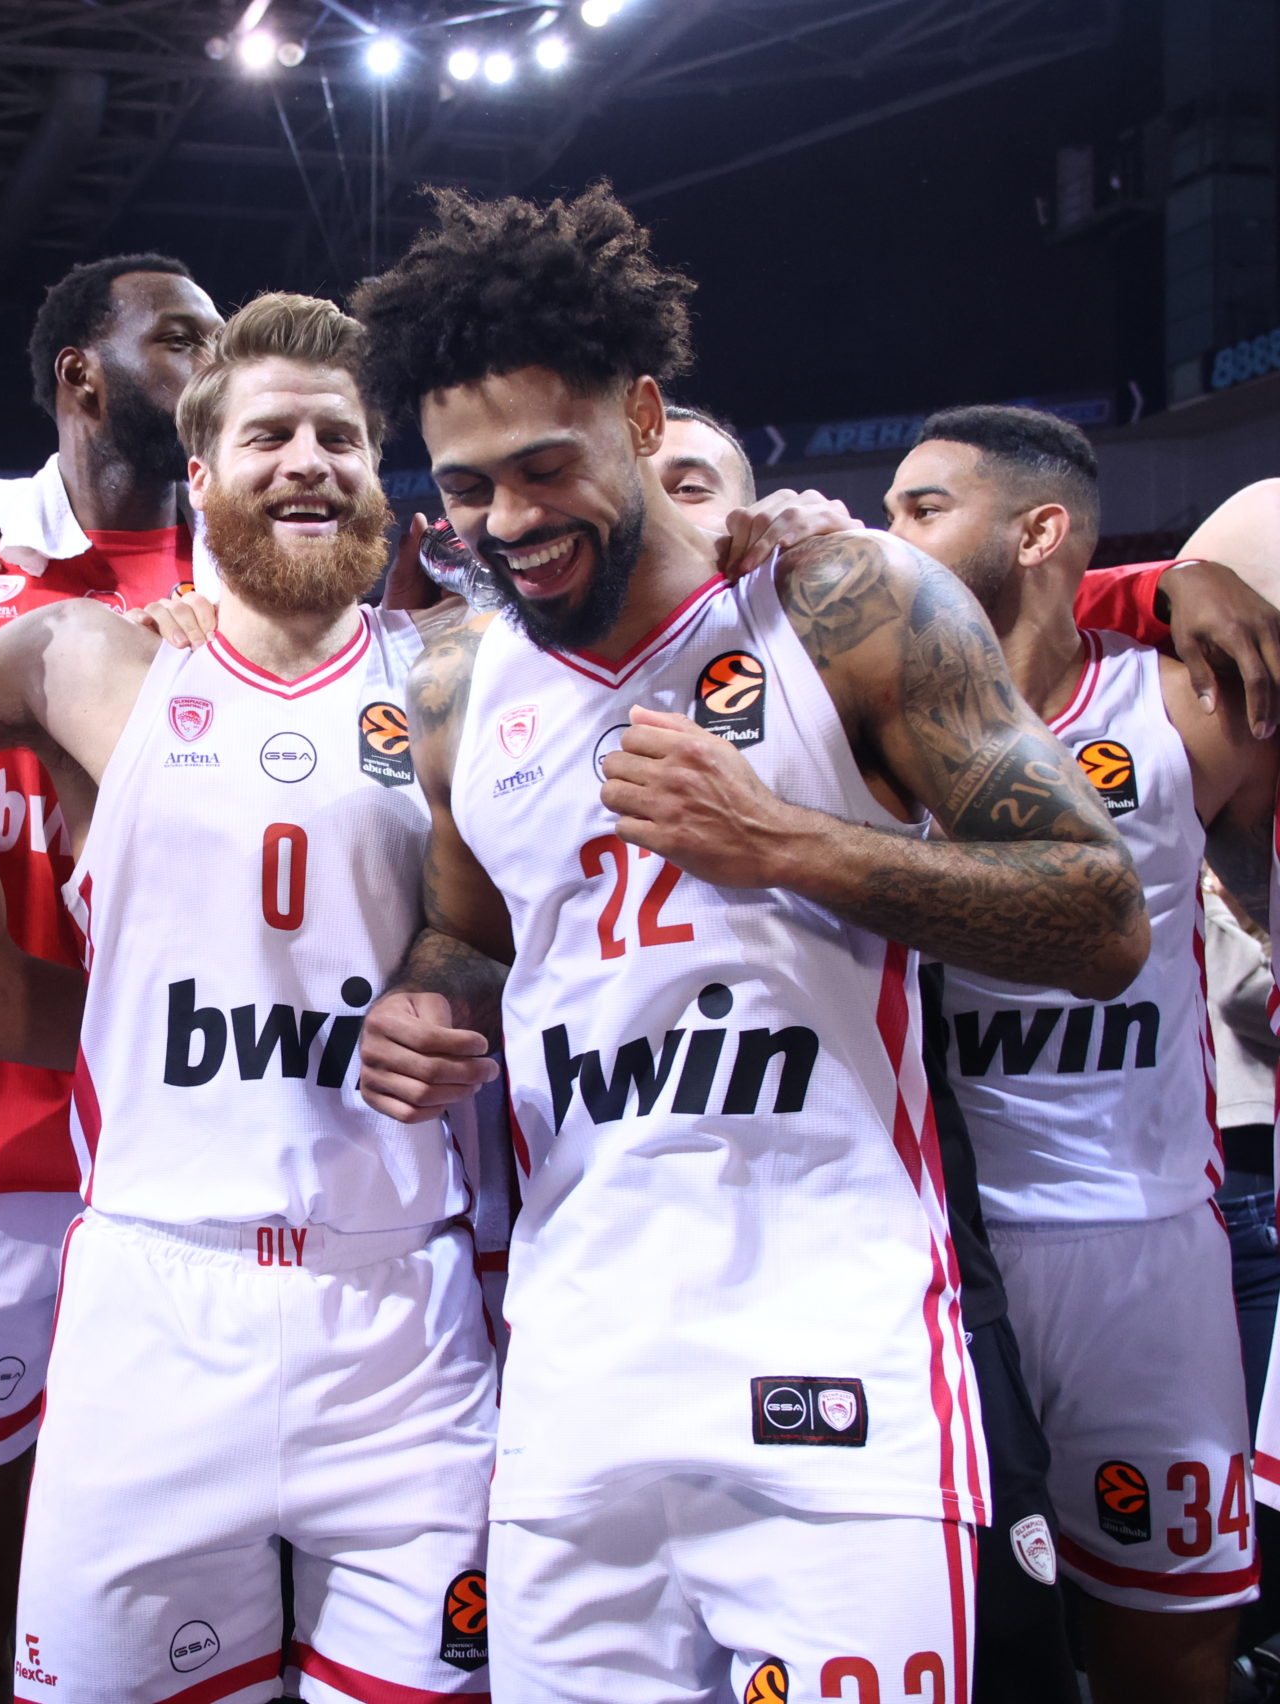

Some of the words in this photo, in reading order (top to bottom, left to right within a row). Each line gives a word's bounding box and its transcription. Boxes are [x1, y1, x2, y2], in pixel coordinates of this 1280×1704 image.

[264, 751, 312, 762] GSA
[362, 763, 382, 774] abu
[383, 767, 411, 780] dhabi
[990, 760, 1068, 828] 210
[262, 823, 308, 931] 0
[579, 834, 694, 960] 22
[164, 976, 373, 1089] bwi
[954, 1001, 1160, 1077] win
[257, 1226, 308, 1267] OLY
[767, 1403, 803, 1412] GSA
[1167, 1452, 1250, 1557] 34
[173, 1638, 216, 1658] GSA
[444, 1647, 465, 1658] abu
[466, 1647, 488, 1658] dha
[15, 1660, 58, 1687] FlexCar
